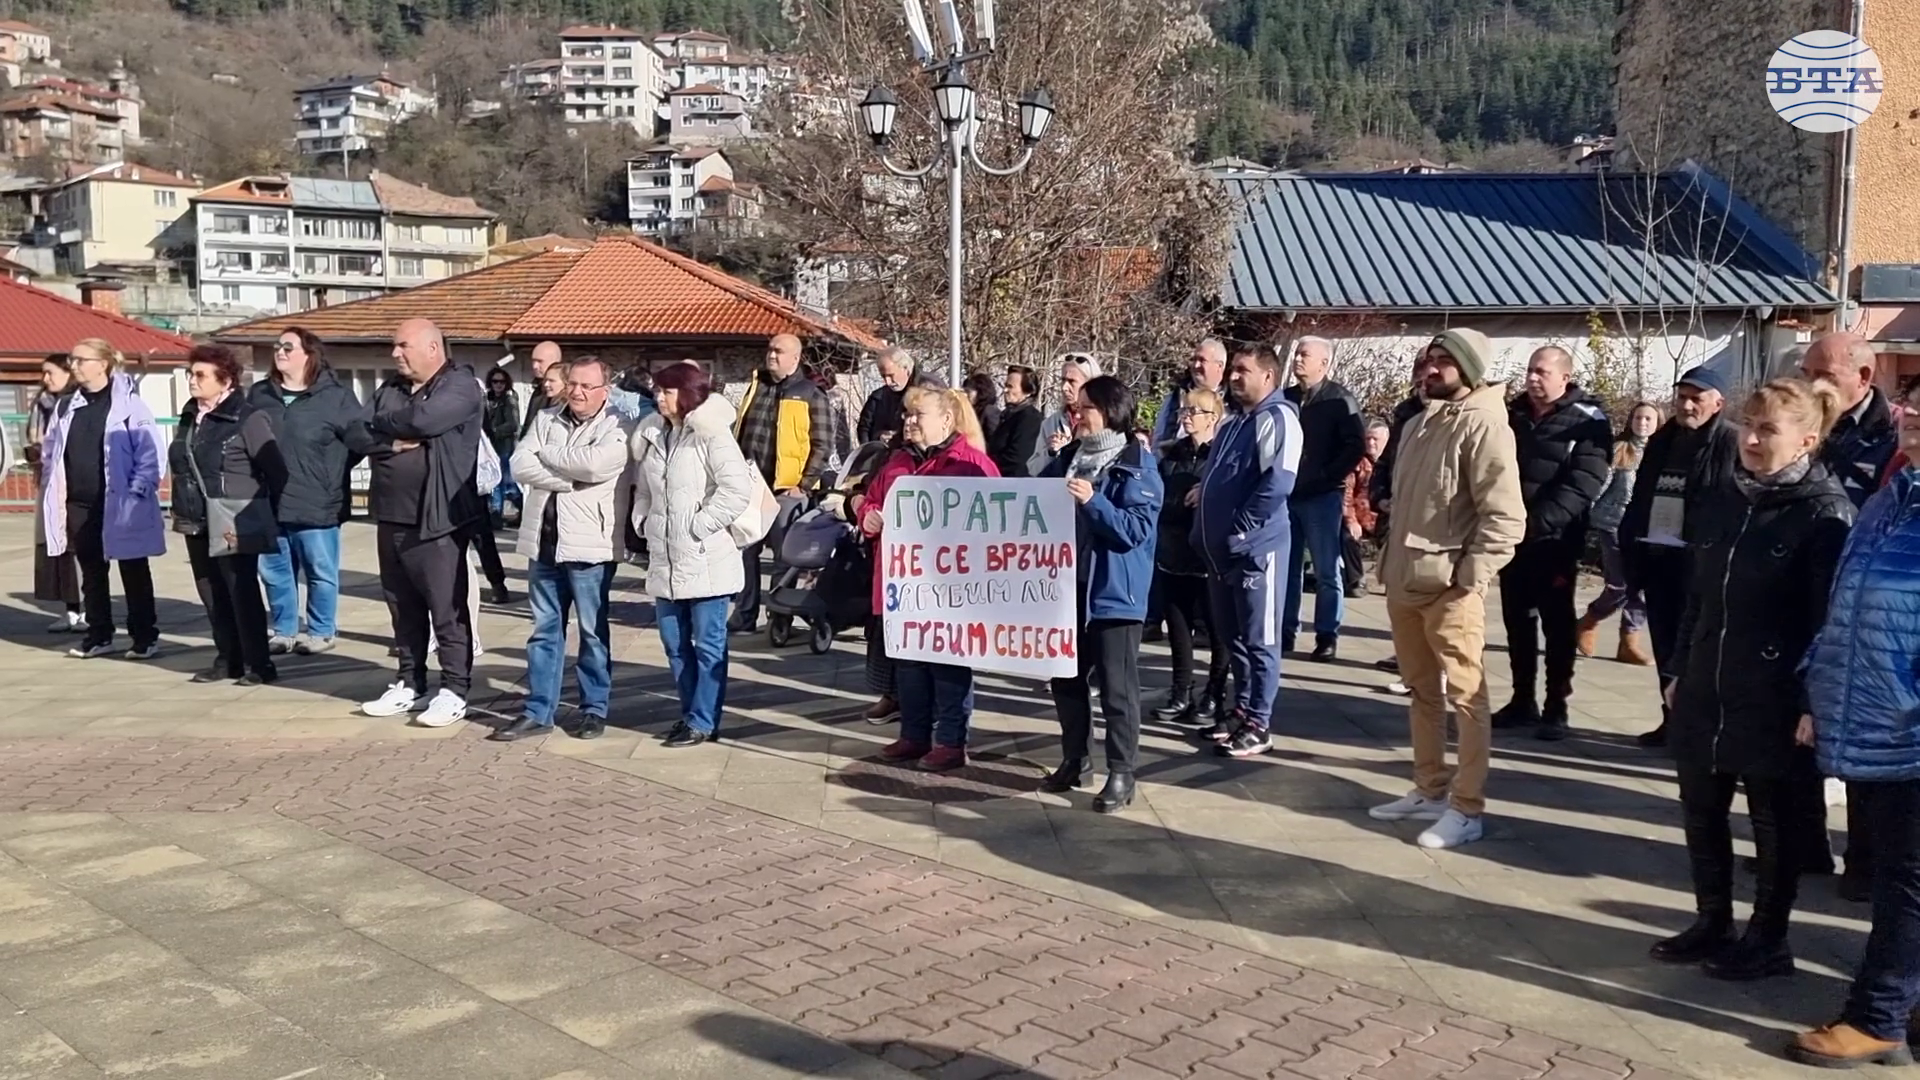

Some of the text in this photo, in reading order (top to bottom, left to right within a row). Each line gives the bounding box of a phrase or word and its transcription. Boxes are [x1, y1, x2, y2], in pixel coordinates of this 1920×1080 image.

[895, 488, 1048, 537] ГОРАТА
[889, 542, 1073, 579] НЕ СЕ ВРЪЩА
[886, 579, 1058, 612] ЗАГУБИМ ЛИ
[902, 620, 987, 658] ГУБИМ
[994, 624, 1075, 659] СЕБЕСИ
